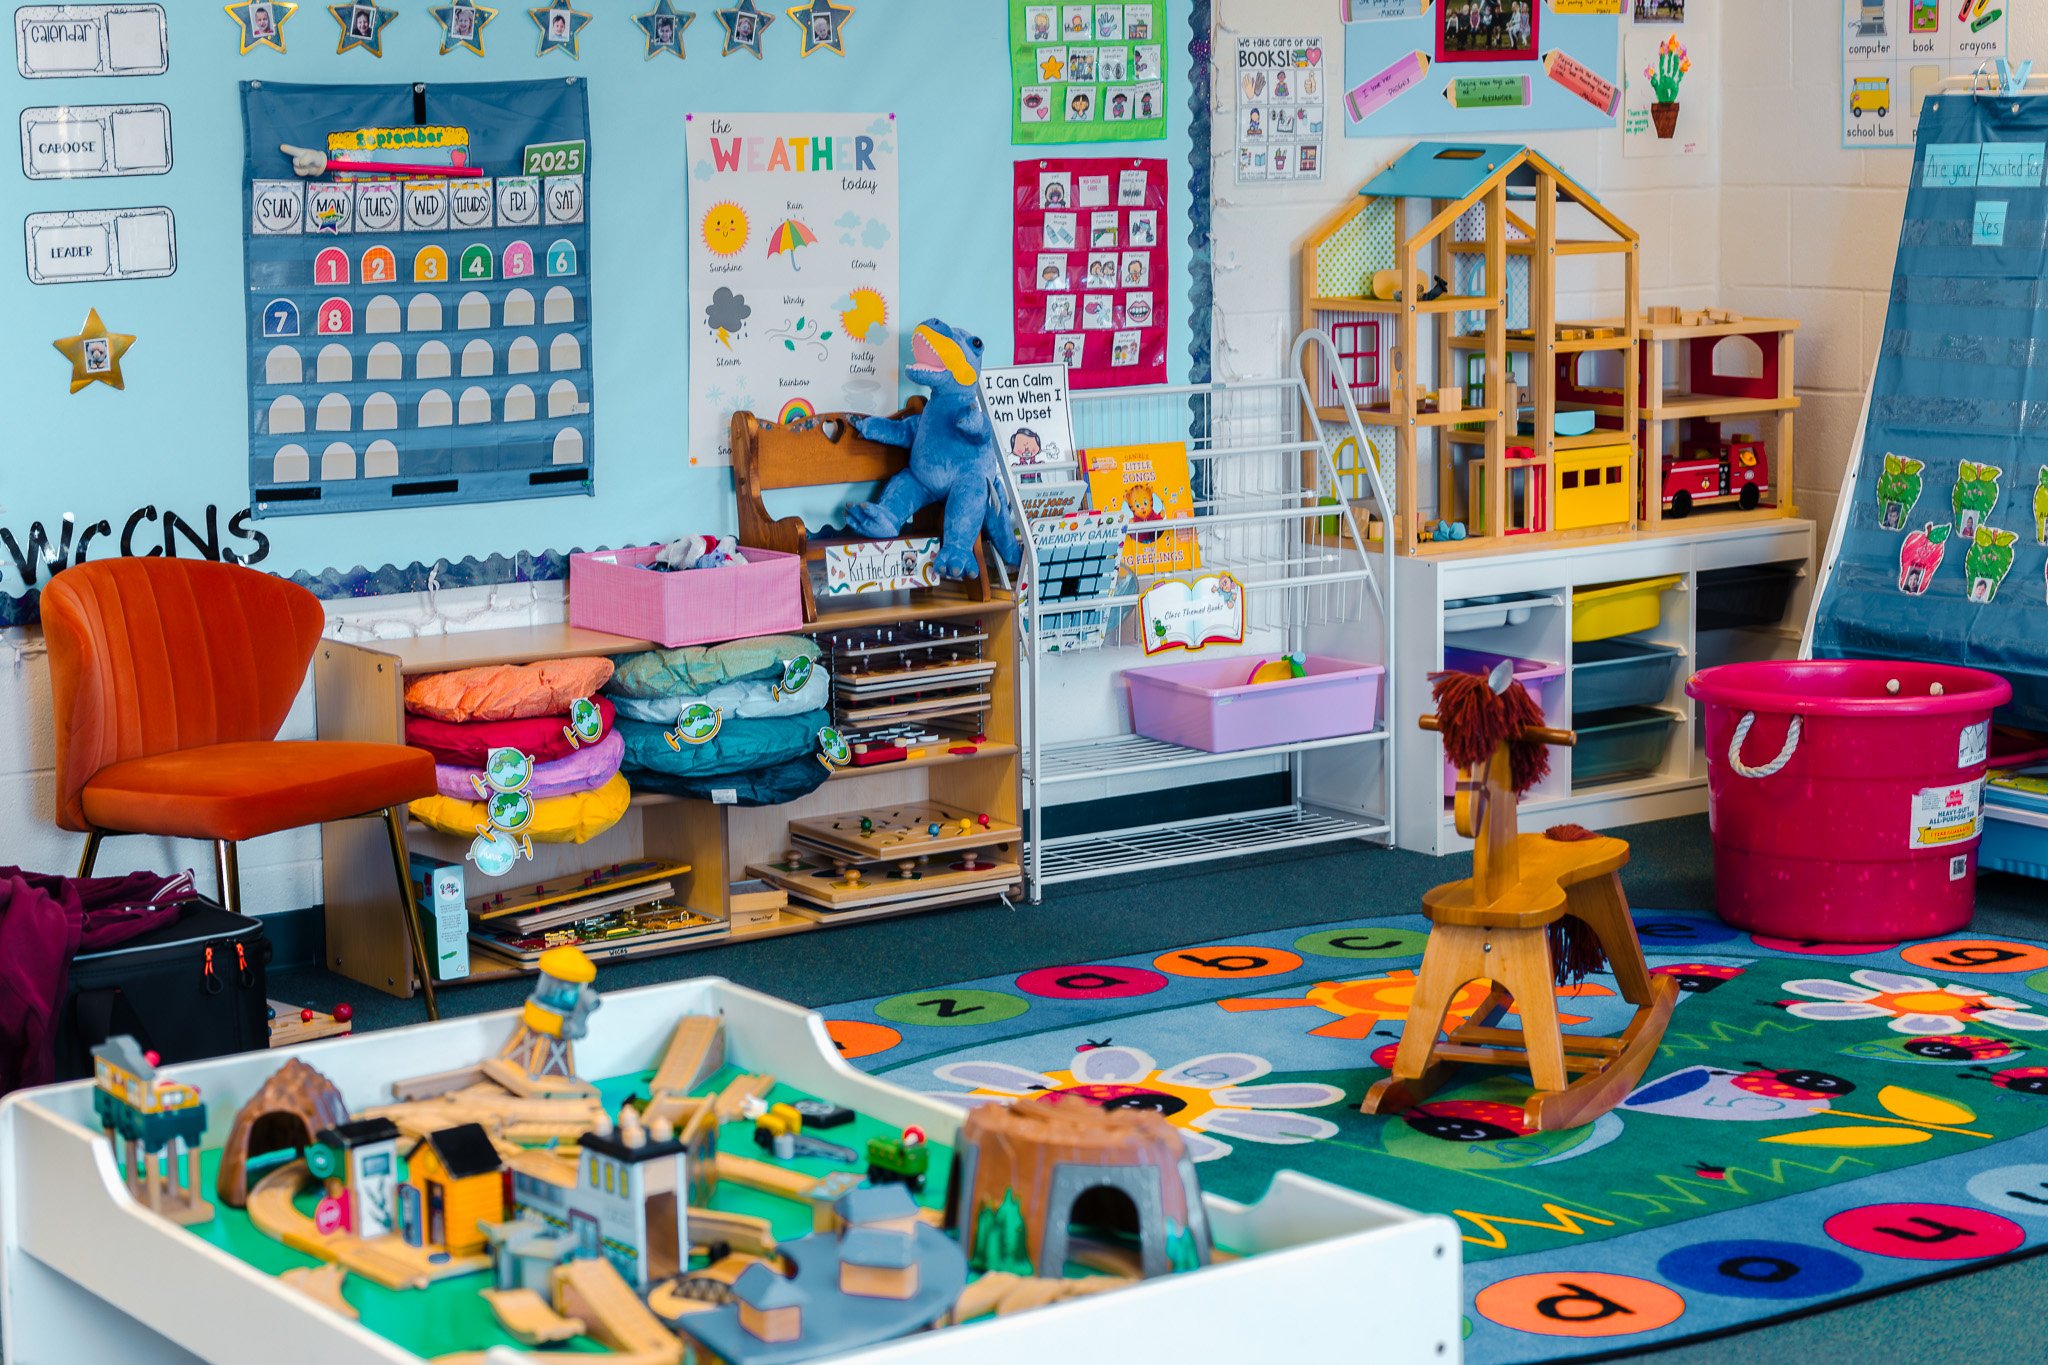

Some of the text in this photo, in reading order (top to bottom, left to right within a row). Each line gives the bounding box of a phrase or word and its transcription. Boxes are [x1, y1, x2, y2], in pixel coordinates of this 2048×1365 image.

[1238, 38, 1320, 47] We take care of our
[1848, 41, 1891, 60] computer
[1912, 39, 1935, 52] book
[1959, 40, 1997, 56] crayons
[1239, 49, 1291, 68] BOOKS!
[1362, 88, 1369, 98] I
[712, 119, 732, 134] the
[1846, 124, 1894, 138] school bus
[356, 130, 443, 147] September
[38, 141, 97, 155] CABOOSE
[710, 135, 876, 172] WEATHER
[529, 149, 580, 173] 2025
[841, 176, 877, 195] today
[364, 196, 394, 217] TUES
[413, 195, 440, 216] WED
[455, 195, 488, 215] THURS
[509, 191, 528, 212] FRI
[556, 189, 576, 211] SAT
[786, 200, 805, 211] Rain
[262, 198, 293, 220] SUN
[1979, 212, 2000, 237] Yes
[51, 246, 93, 259] LEADER
[328, 260, 338, 281] 1
[371, 258, 386, 280] 2
[424, 257, 438, 279] 3
[468, 256, 485, 277] 4
[512, 254, 525, 275] 5
[555, 252, 568, 273] 6
[709, 263, 743, 273] Sunshine
[851, 259, 877, 271] Cloudy
[783, 295, 806, 307] Windy
[273, 311, 288, 333] 7
[328, 309, 343, 331] 8
[716, 357, 742, 368] Storm
[851, 351, 876, 363] Partly
[849, 364, 877, 375] Cloudy
[779, 377, 810, 388] Rainbow
[986, 373, 1053, 389] I Can Calm
[1017, 390, 1052, 404] When
[1054, 388, 1062, 402] I
[994, 406, 1052, 423] Am Upset
[1125, 461, 1152, 471] LITTLE
[1122, 471, 1157, 484] SONGS
[1038, 528, 1119, 546] MEMORY GAME
[848, 553, 901, 582] Kit the Cat
[1164, 603, 1223, 620] Class Themed Books
[1929, 814, 1966, 825] ALL-PURPOSE
